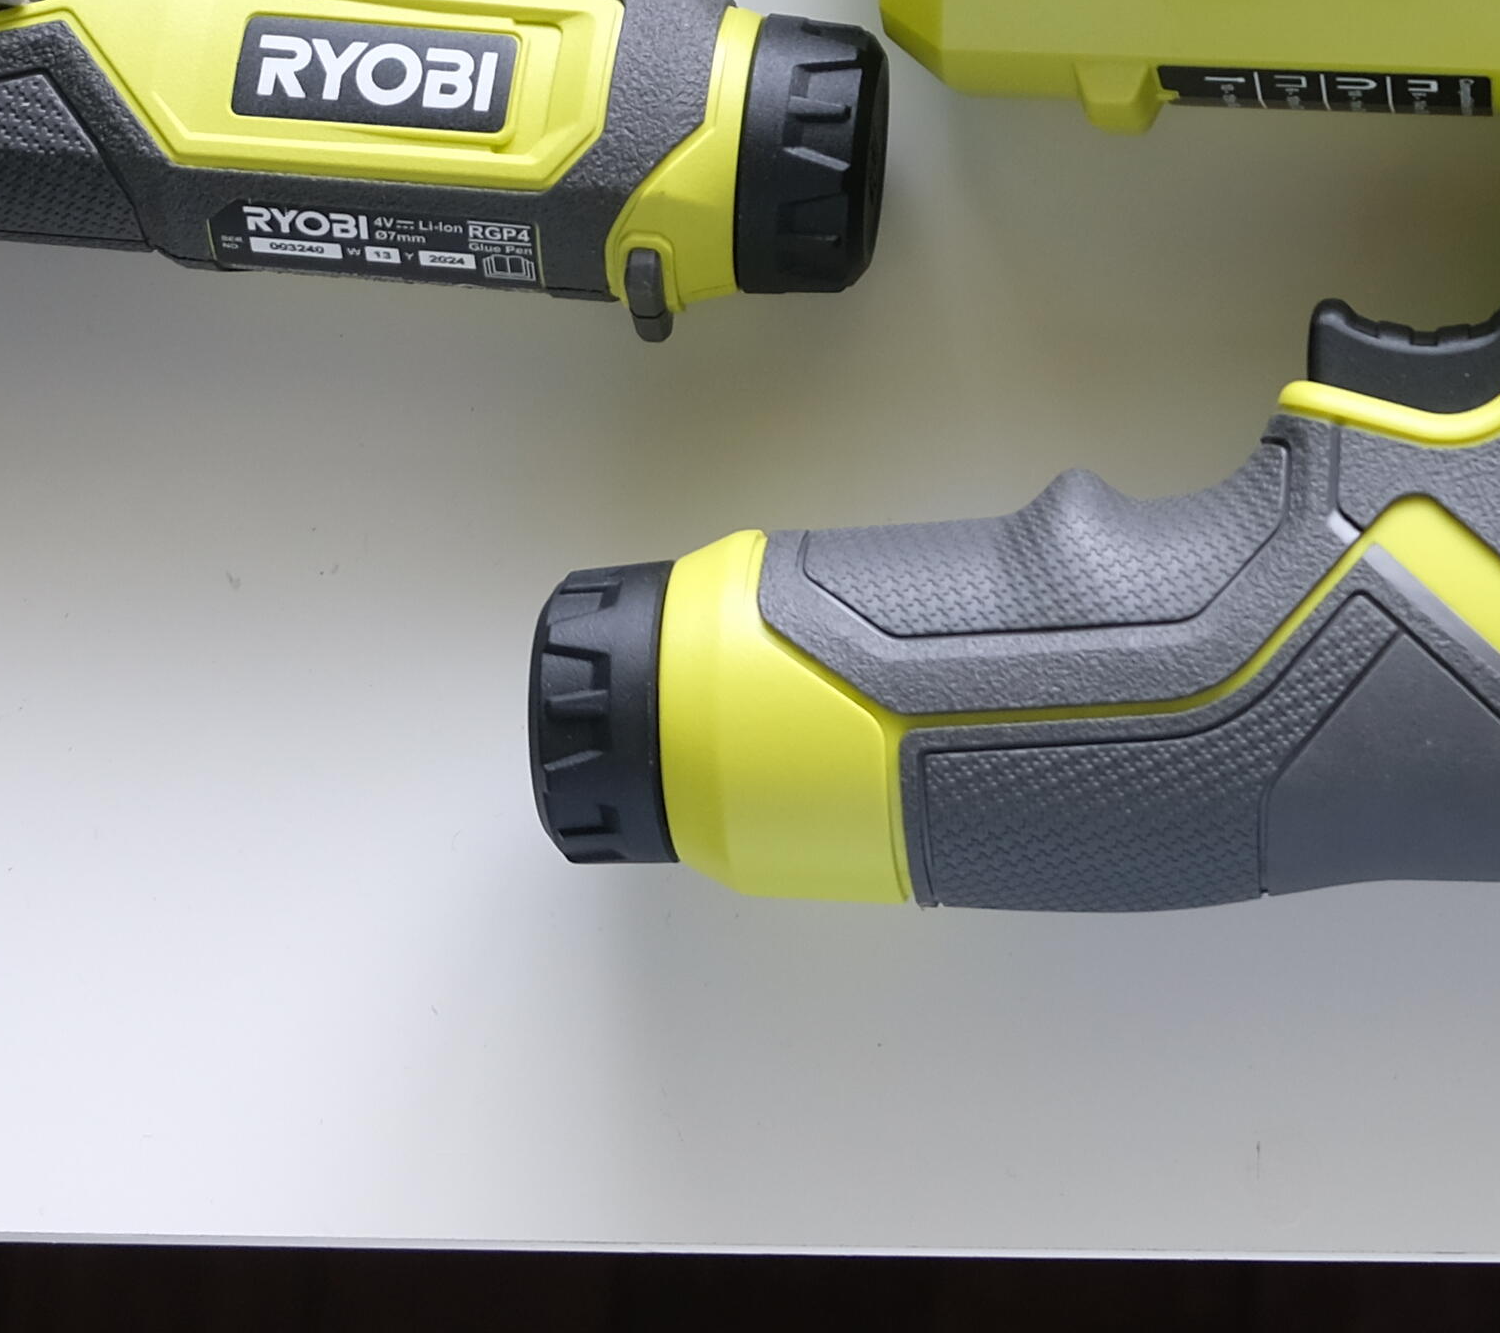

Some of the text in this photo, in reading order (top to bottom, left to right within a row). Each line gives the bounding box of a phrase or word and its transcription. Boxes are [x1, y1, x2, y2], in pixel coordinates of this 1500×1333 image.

[253, 33, 499, 113] RYOBI
[242, 206, 369, 240] RYOBI
[373, 216, 463, 234] 4V Li-Ion
[468, 224, 531, 242] RGP4
[347, 247, 362, 257] W
[404, 252, 415, 261] Y
[429, 254, 466, 266] 2024
[468, 242, 533, 256] Glue Pen
